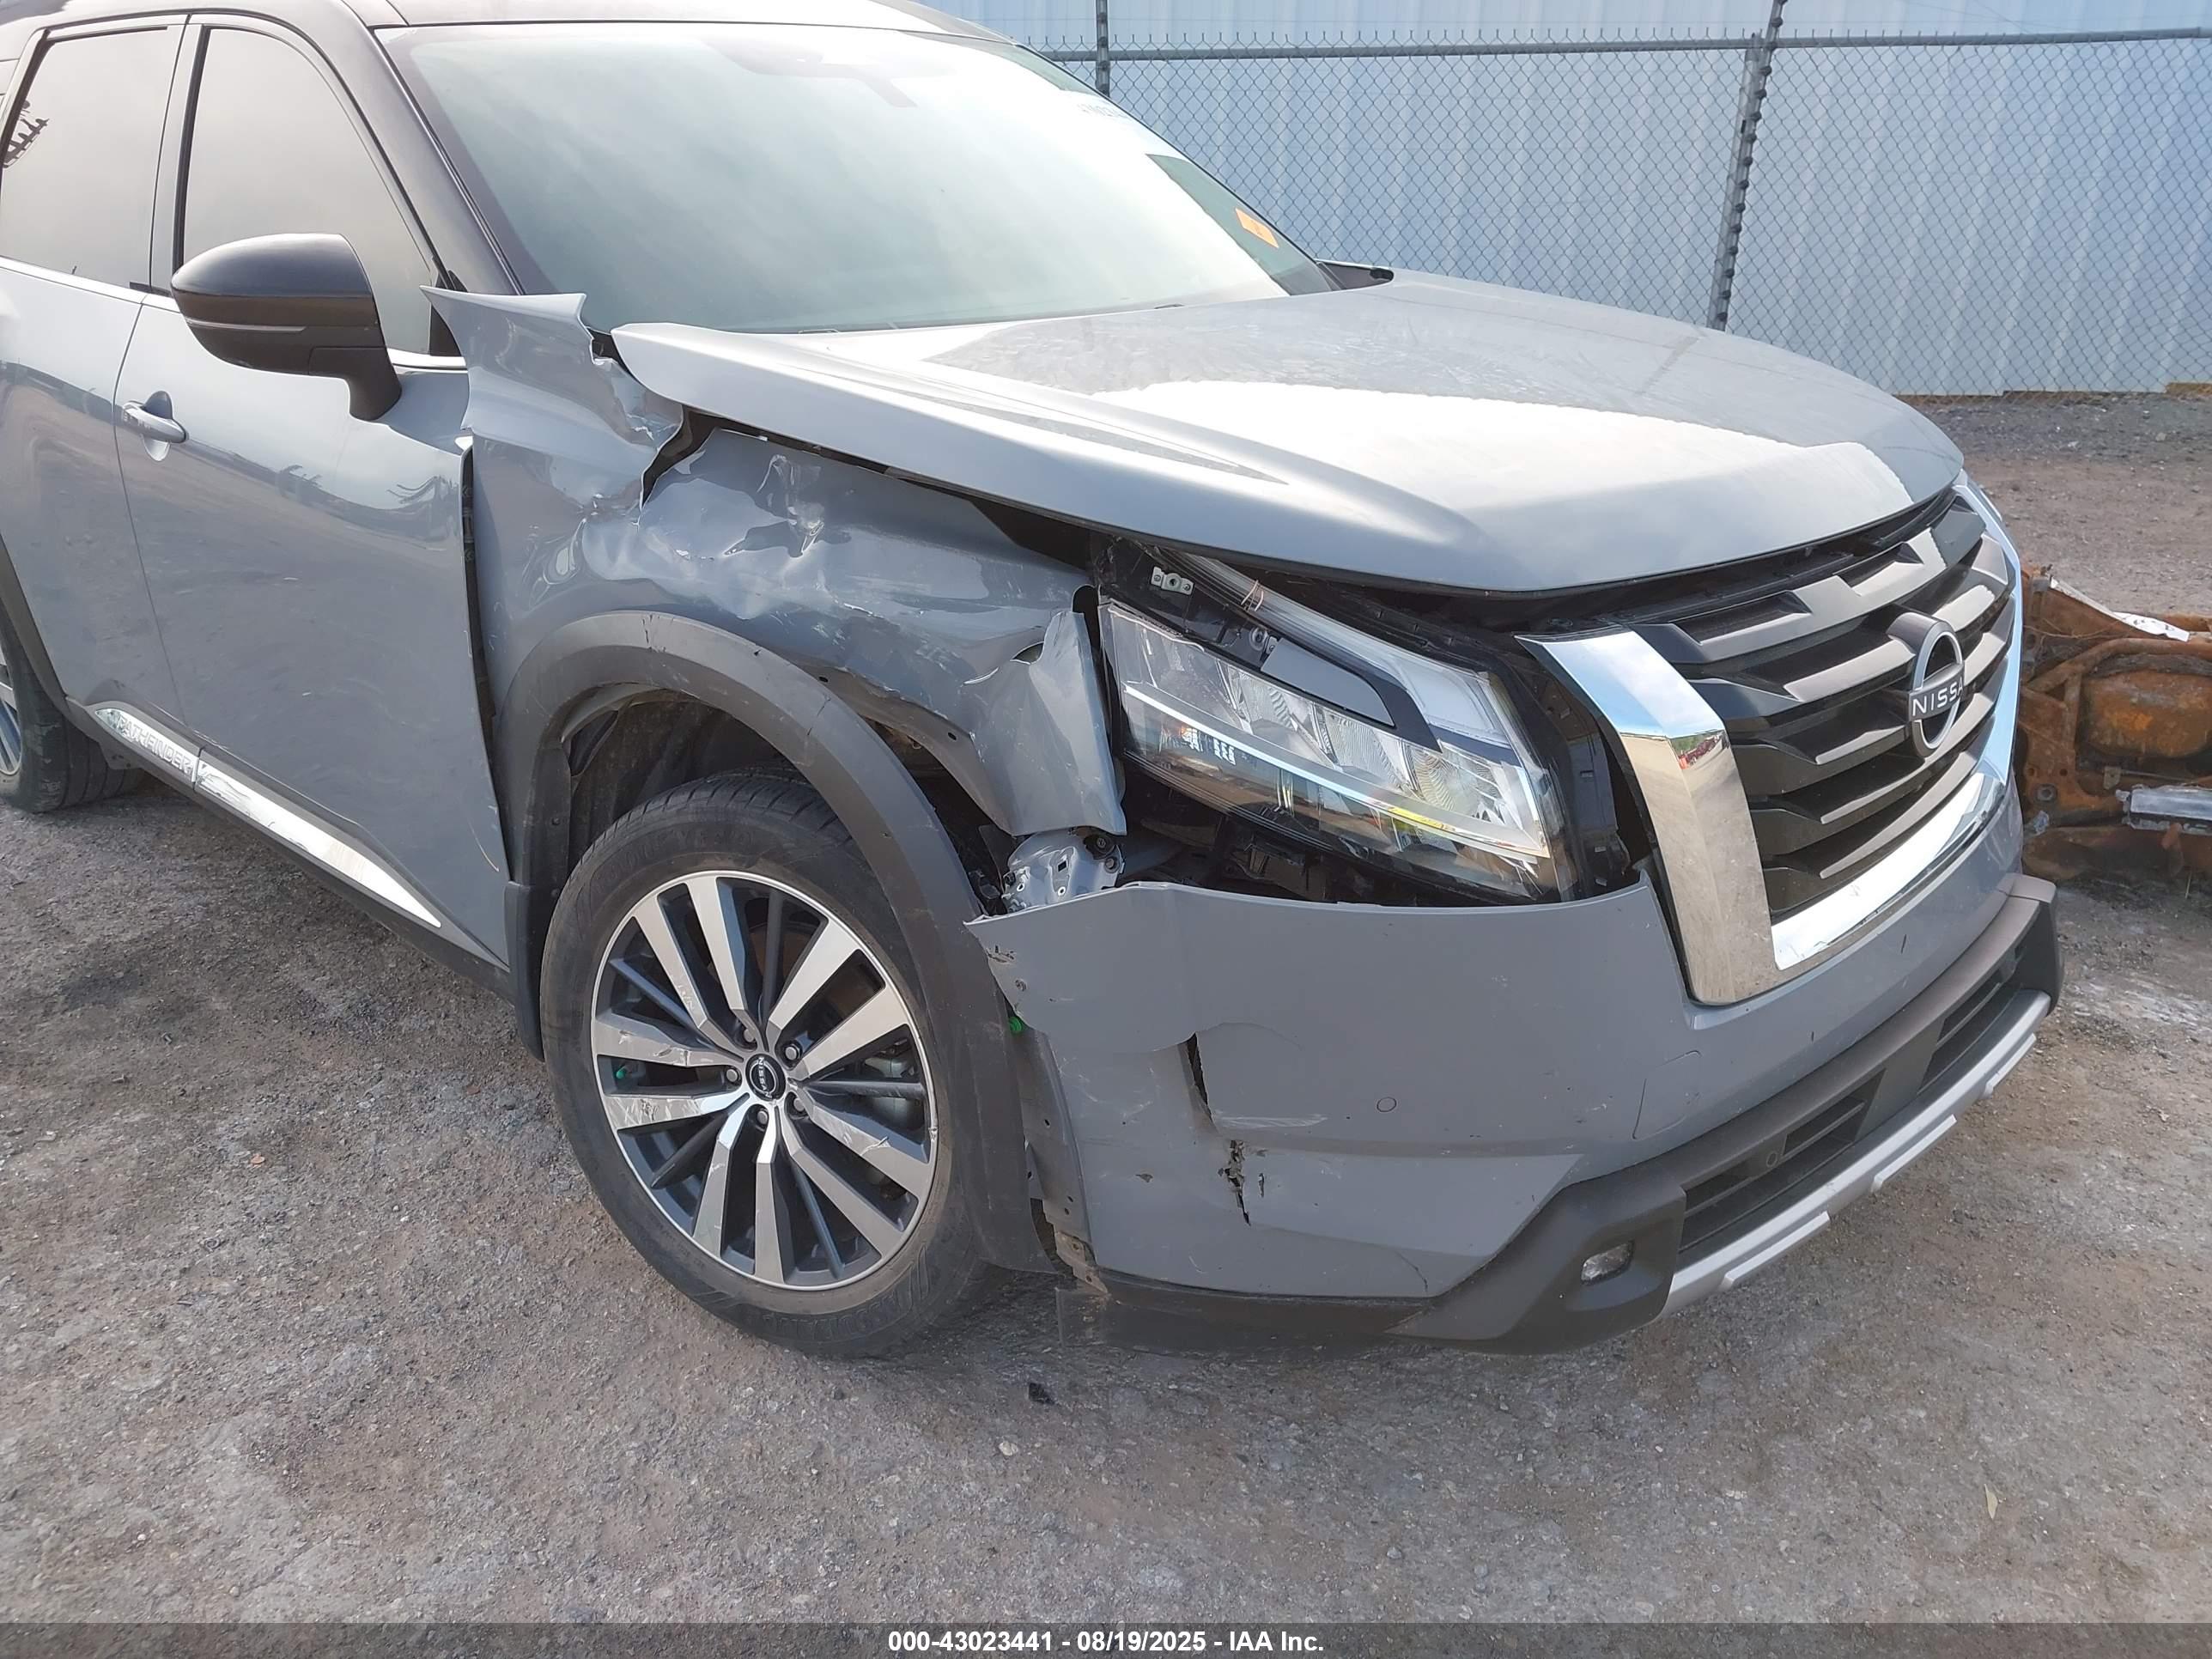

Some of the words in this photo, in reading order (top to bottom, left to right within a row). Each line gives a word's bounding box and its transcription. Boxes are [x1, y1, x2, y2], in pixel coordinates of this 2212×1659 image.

[1911, 677, 1963, 717] NISSA
[117, 714, 193, 777] PATHFINDER
[758, 1057, 773, 1098] NISSAN
